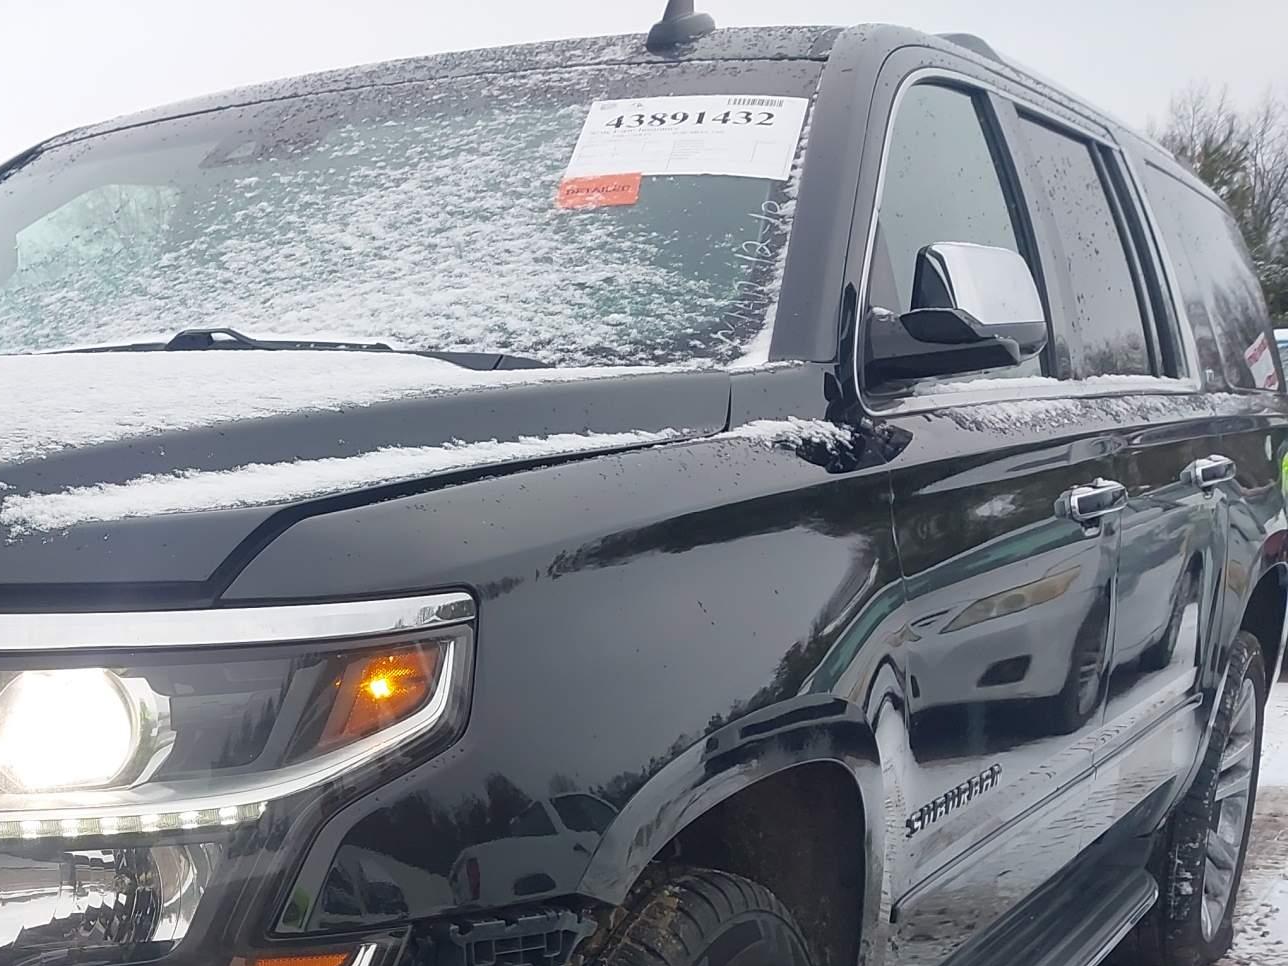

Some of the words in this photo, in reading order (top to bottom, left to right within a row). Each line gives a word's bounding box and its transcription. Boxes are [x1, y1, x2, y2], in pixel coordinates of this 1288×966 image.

[605, 110, 775, 129] 43891432
[565, 183, 632, 196] DETAILED
[906, 763, 1002, 838] SUBURBAN
